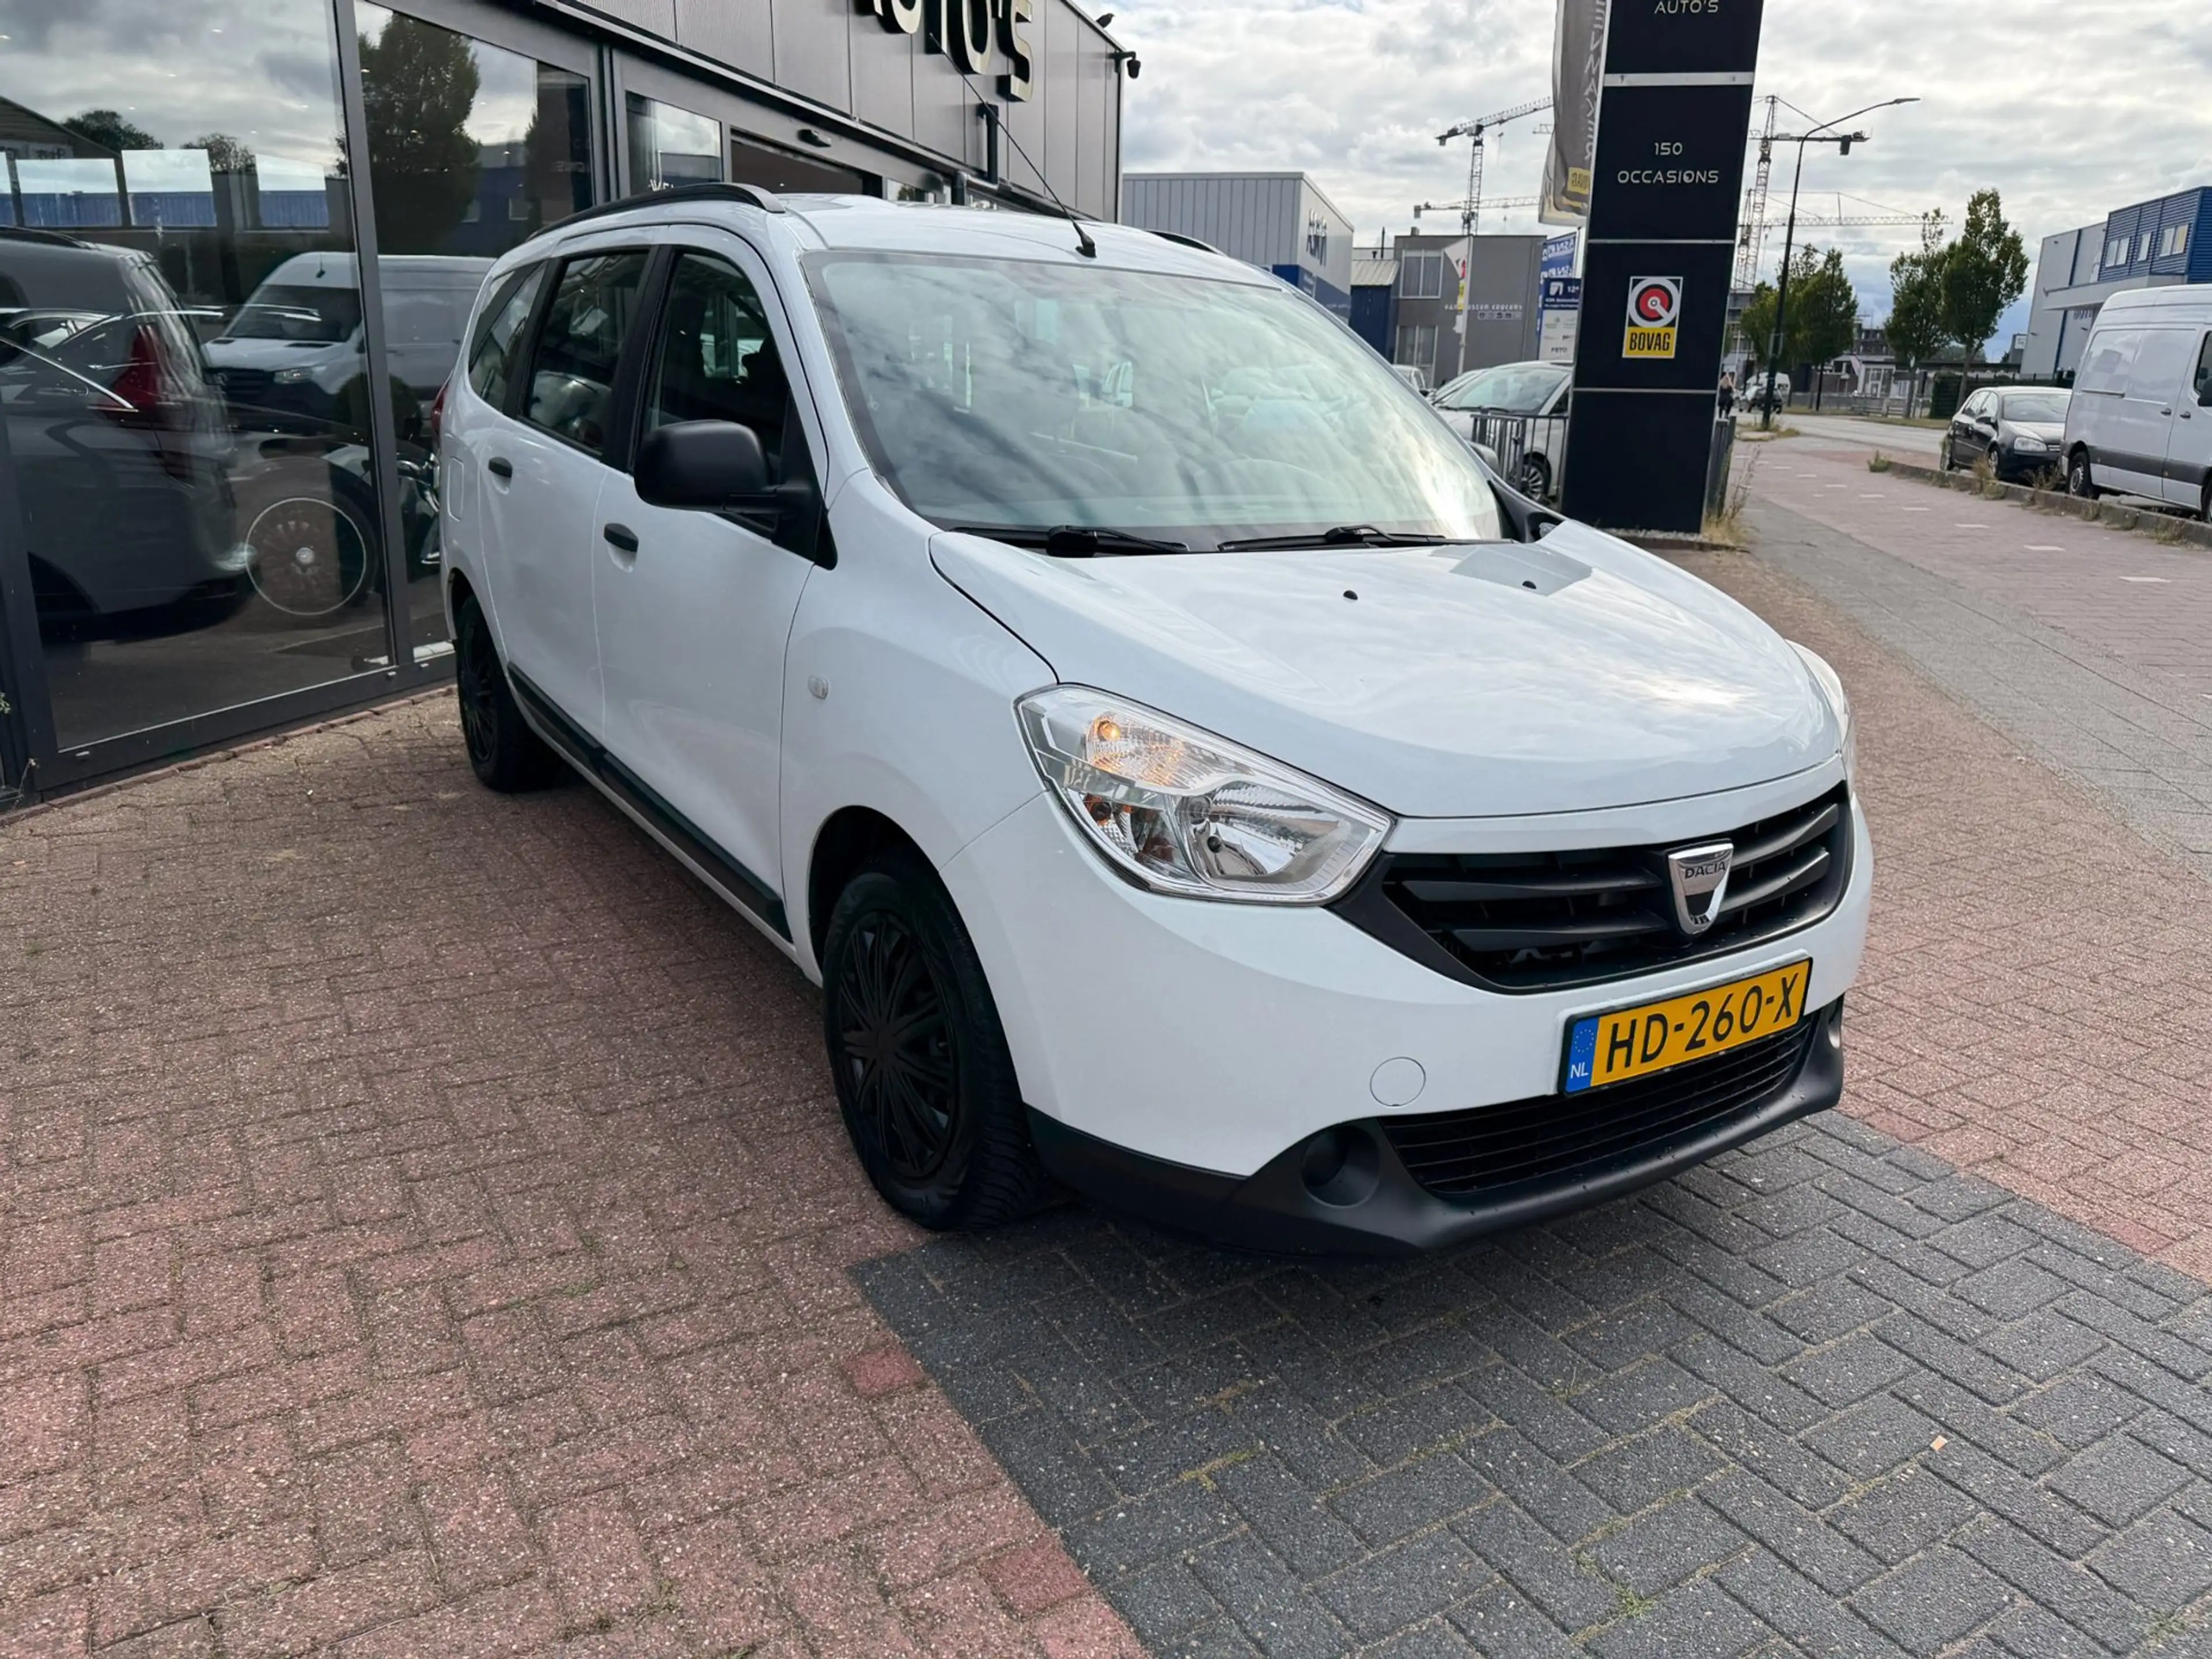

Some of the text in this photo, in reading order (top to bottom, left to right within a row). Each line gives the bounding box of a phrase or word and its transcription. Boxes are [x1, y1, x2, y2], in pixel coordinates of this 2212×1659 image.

[1654, 0, 1718, 14] AUTO'S
[1654, 142, 1683, 156] 150
[1617, 170, 1719, 184] OCCASIONS
[1629, 332, 1671, 351] BOVAG
[1684, 861, 1726, 880] DACIA
[1605, 972, 1799, 1073] HD-260-X
[1570, 1062, 1589, 1079] NL
